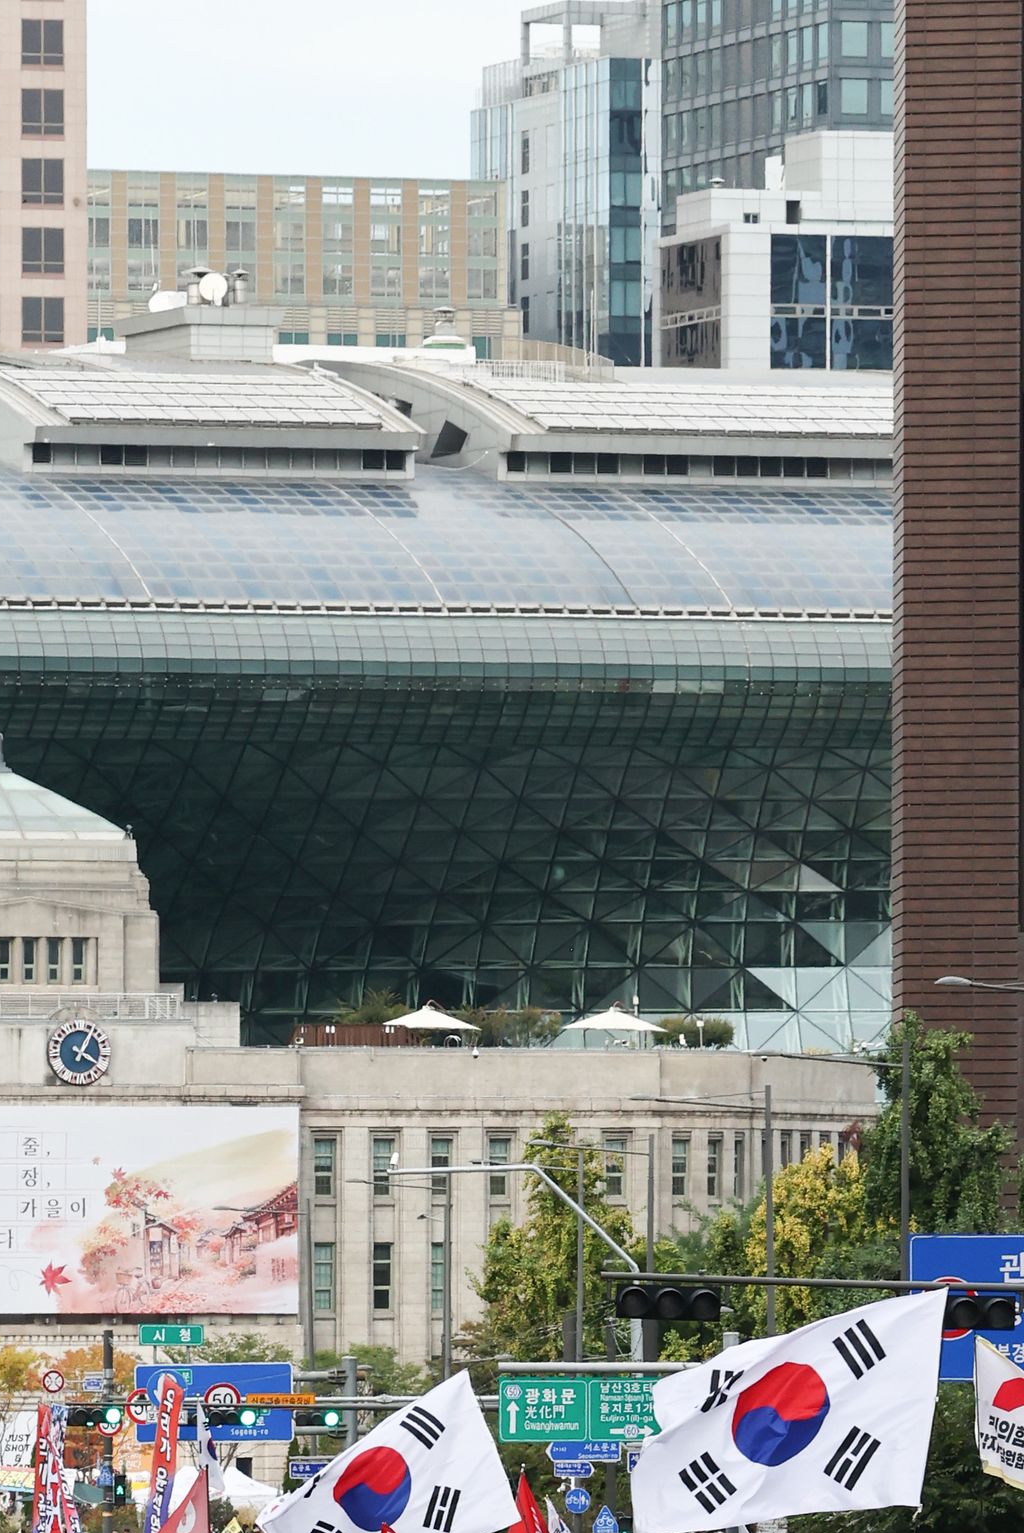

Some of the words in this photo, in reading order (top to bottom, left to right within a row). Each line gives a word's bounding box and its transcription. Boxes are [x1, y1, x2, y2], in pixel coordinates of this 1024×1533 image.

[21, 1136, 51, 1157] 줄,
[21, 1167, 51, 1188] 장,
[20, 1198, 87, 1219] 가을이
[525, 1388, 576, 1404] 광화문
[525, 1405, 565, 1419] 光化門
